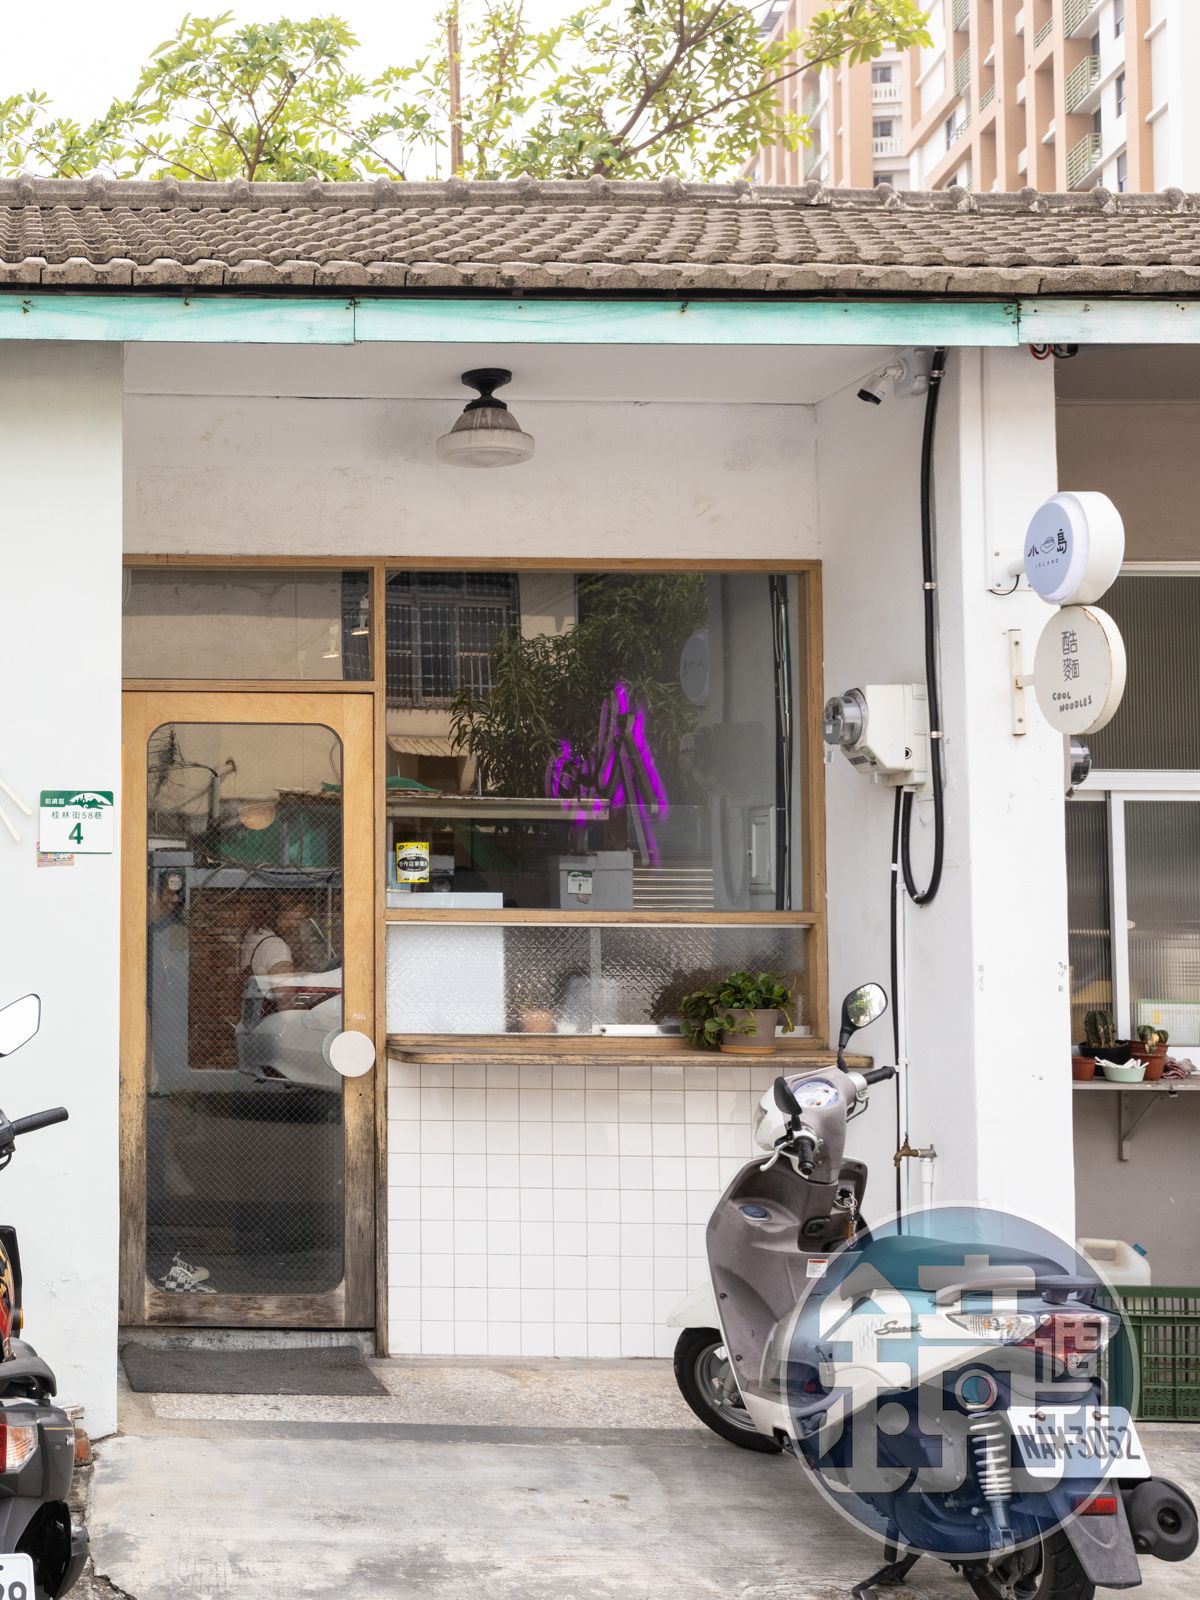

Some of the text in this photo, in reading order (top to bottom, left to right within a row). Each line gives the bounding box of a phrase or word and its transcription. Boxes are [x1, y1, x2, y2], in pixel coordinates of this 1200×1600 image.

[1027, 528, 1068, 557] 小島
[1061, 629, 1080, 682] 酷麵
[1052, 691, 1071, 701] COOL
[1059, 694, 1093, 713] NOODLES
[51, 811, 103, 820] 桂林街58巷
[68, 822, 84, 844] 4
[352, 1012, 368, 1020] PULL
[1017, 1424, 1141, 1461] NAM-3052
